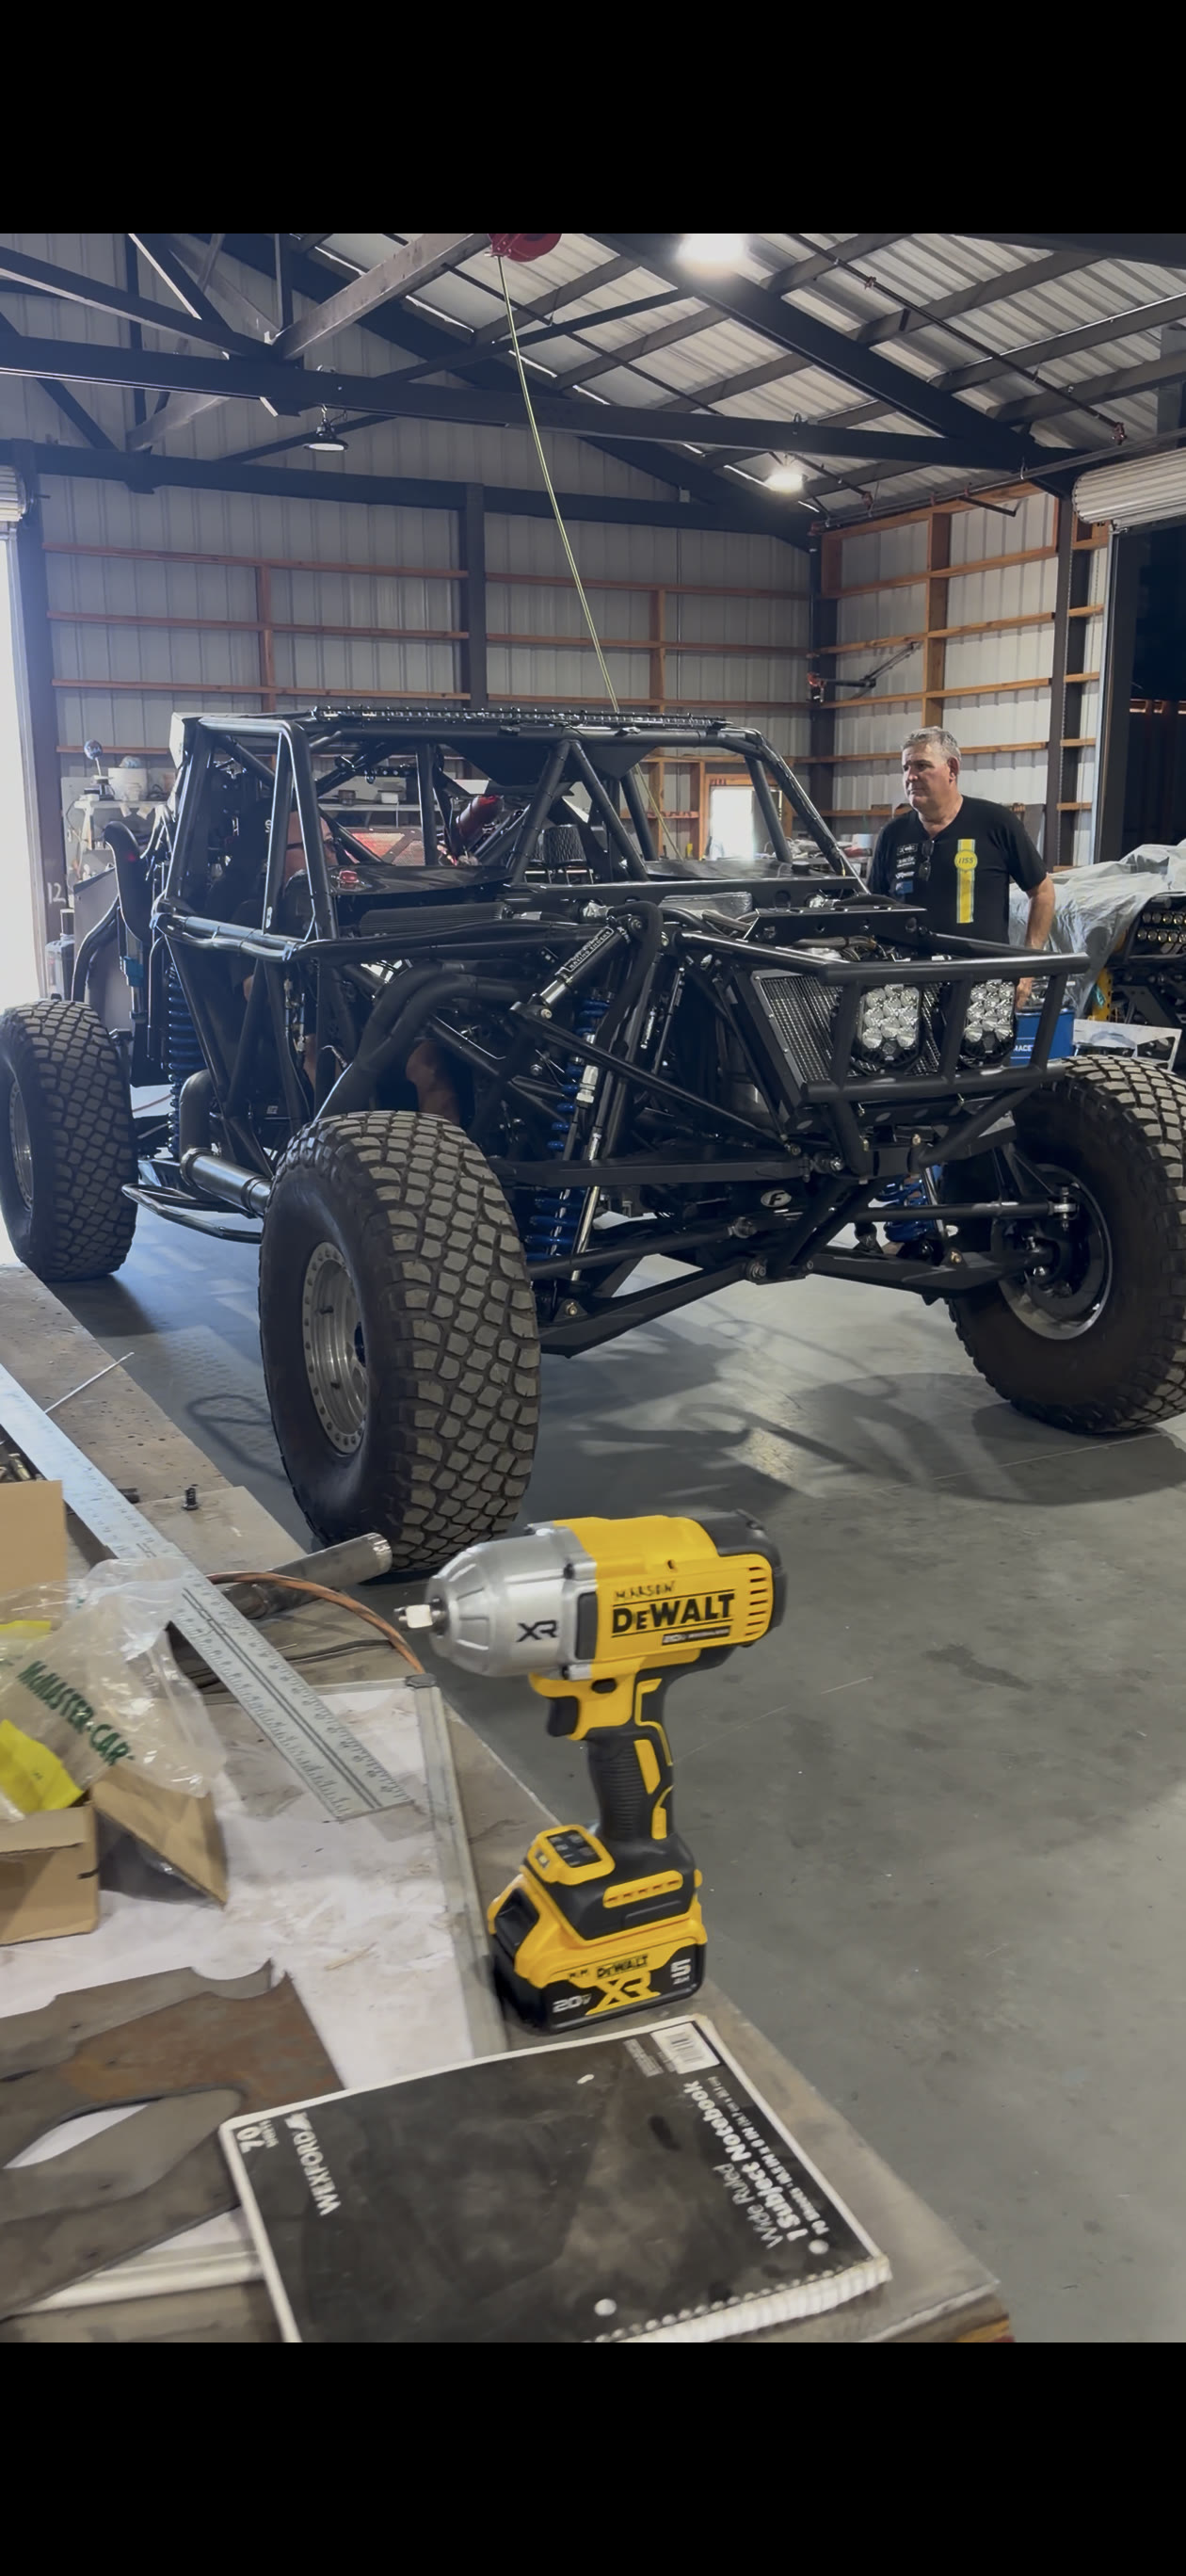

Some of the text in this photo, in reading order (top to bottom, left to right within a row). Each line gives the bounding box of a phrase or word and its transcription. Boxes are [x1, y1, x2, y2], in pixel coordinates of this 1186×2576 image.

[47, 882, 67, 904] 12
[517, 1618, 559, 1642] XR
[16, 1660, 136, 1767] McMASTER-CAR
[670, 1958, 692, 1978] 5
[585, 1972, 662, 2016] XR
[236, 2126, 266, 2154] 70
[683, 2080, 809, 2242] 1 Subject Notebook
[293, 2131, 342, 2216] WEXFORD
[712, 2163, 784, 2249] Wide Ruled
